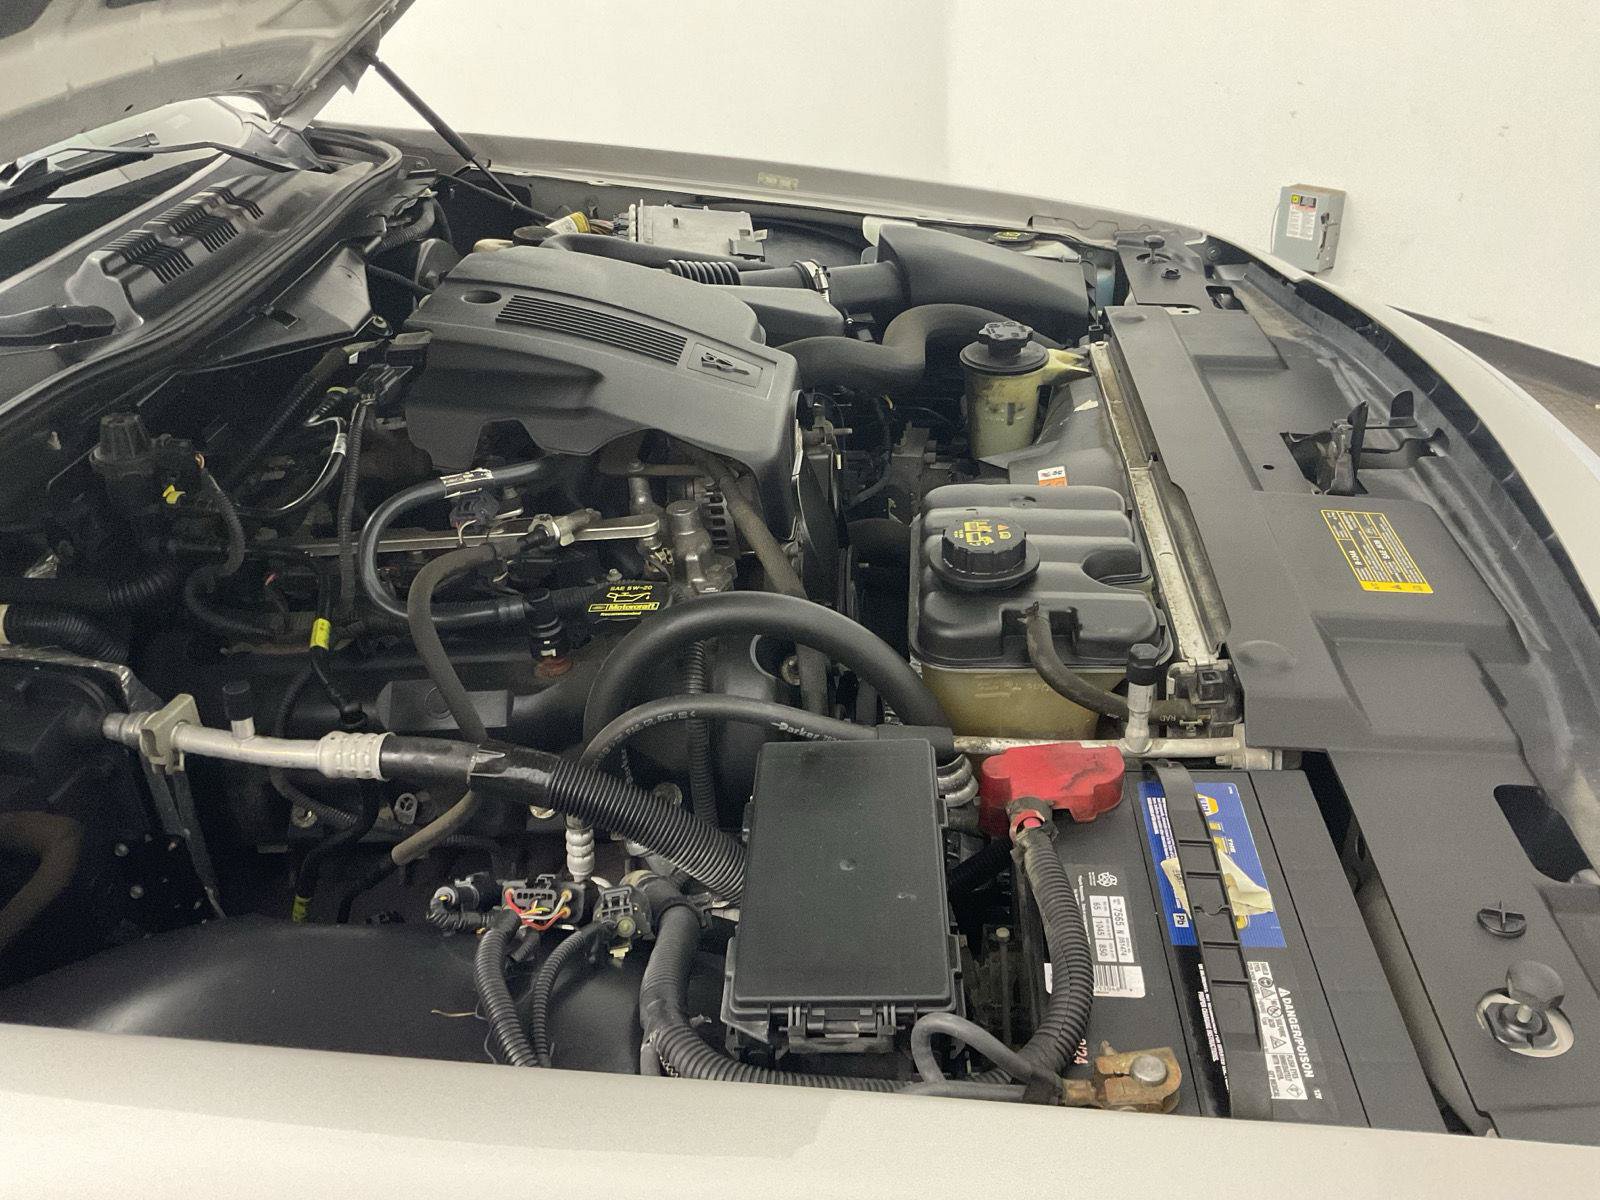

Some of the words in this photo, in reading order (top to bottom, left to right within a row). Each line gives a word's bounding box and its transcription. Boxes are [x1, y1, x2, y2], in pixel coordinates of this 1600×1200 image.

[778, 722, 820, 740] Parker
[1093, 902, 1102, 911] 65
[1113, 908, 1125, 926] 7565
[1176, 914, 1185, 925] Pb
[1096, 920, 1105, 936] 1045
[1098, 943, 1108, 957] 850
[1281, 997, 1315, 1078] DANGER/POISON
